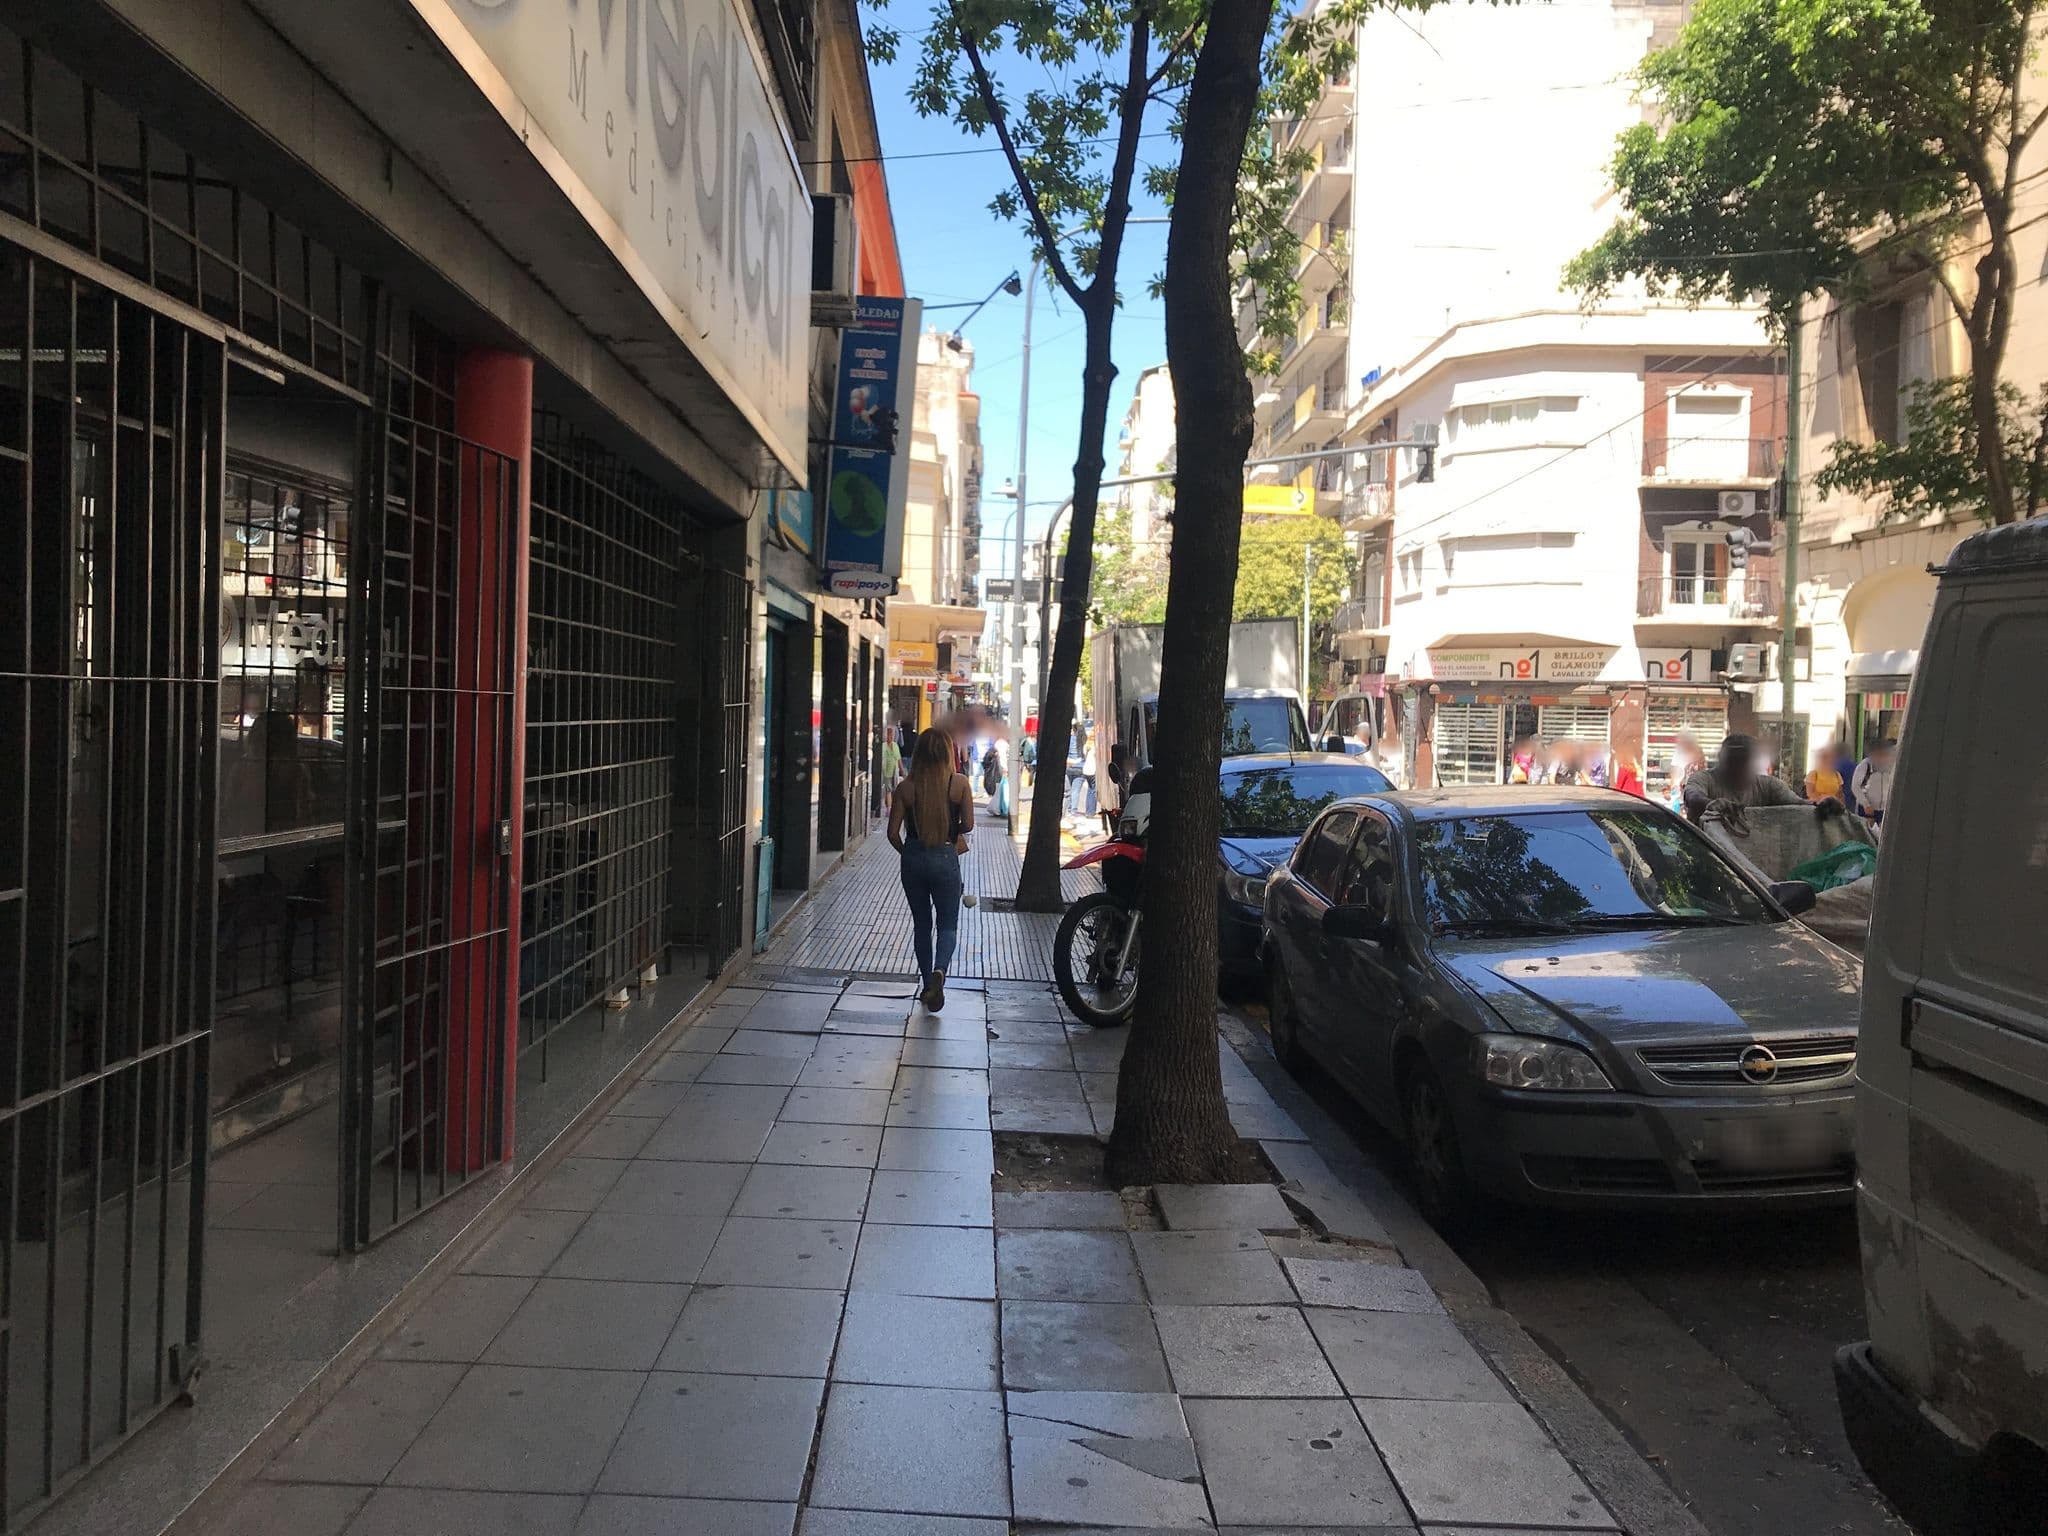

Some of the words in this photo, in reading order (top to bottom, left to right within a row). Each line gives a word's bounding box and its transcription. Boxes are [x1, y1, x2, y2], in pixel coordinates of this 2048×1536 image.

[568, 25, 718, 312] Medicina
[855, 306, 900, 319] OLEDAD
[833, 578, 890, 590] rapipago
[1554, 652, 1595, 660] BRILLO
[1597, 652, 1605, 660] Y
[1551, 661, 1606, 670] GLAMOUR
